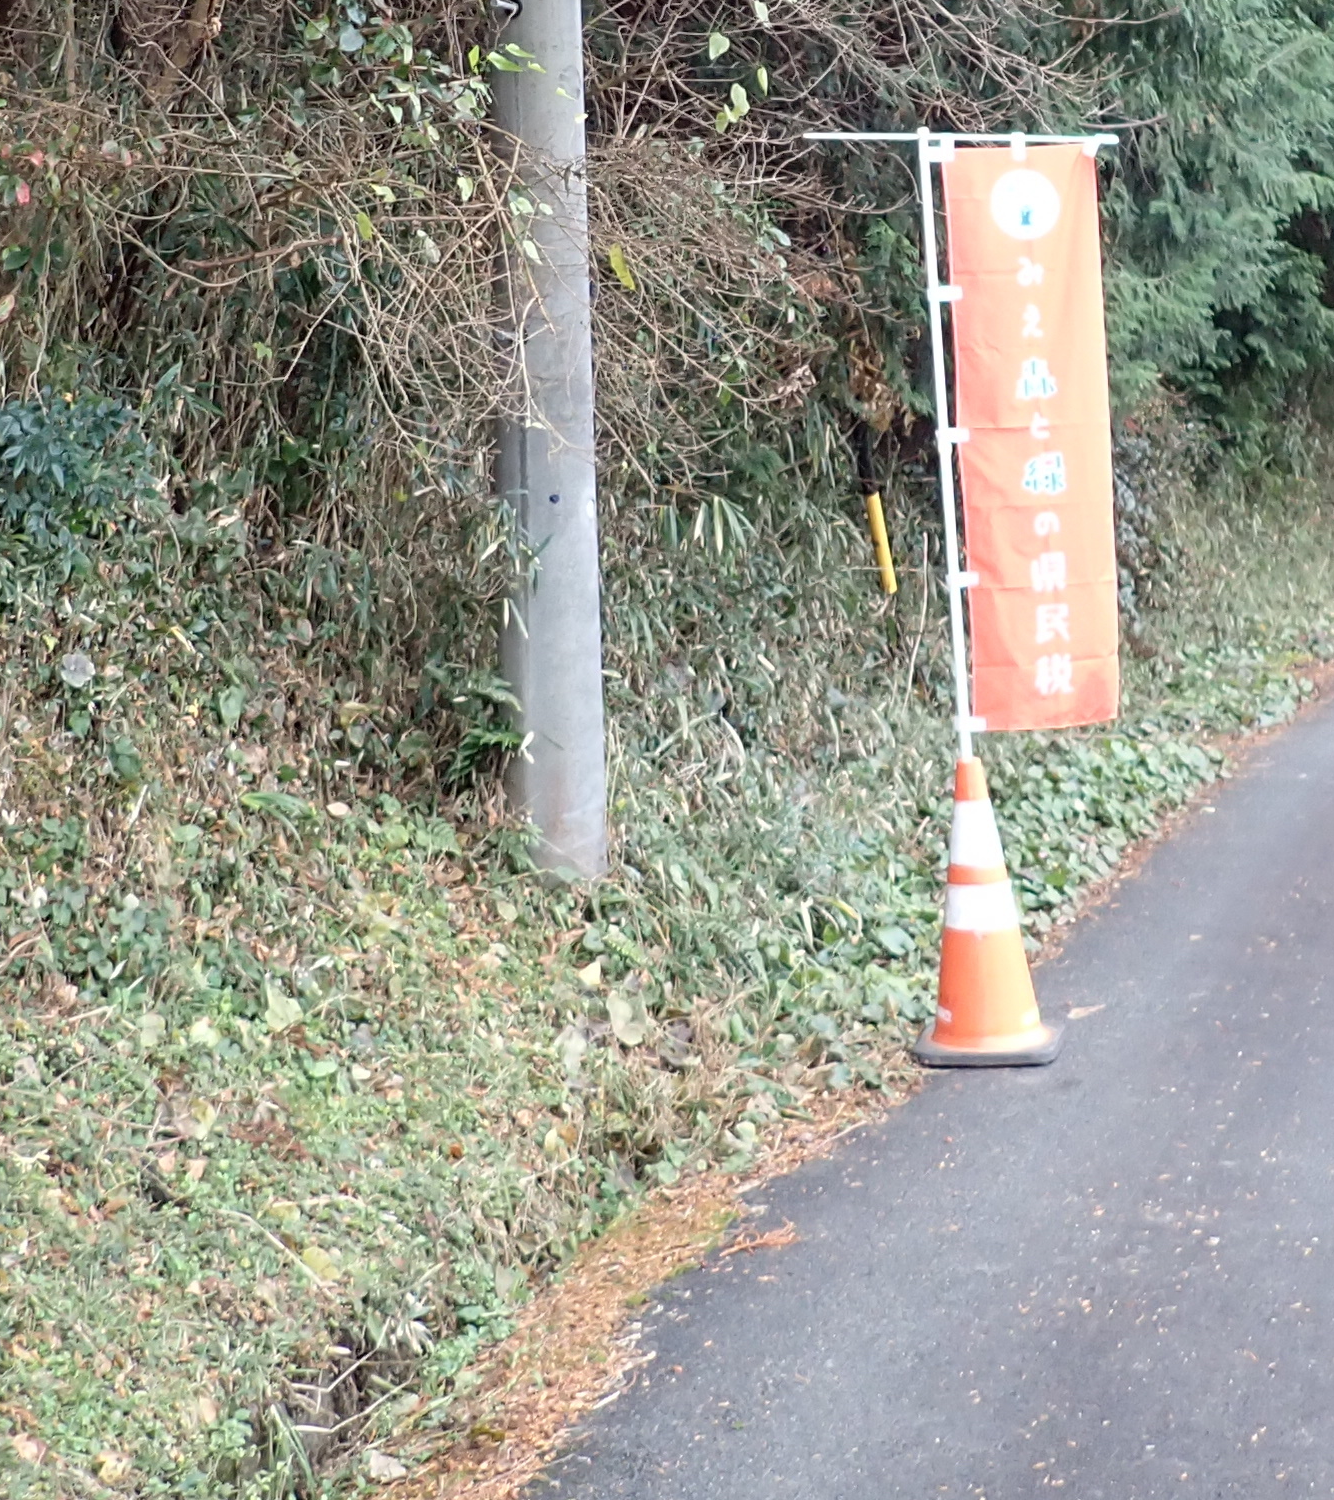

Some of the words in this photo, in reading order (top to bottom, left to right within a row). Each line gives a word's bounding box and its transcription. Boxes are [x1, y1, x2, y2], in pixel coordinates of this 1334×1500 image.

[1015, 256, 1074, 696] みえ森と緑の県民税
